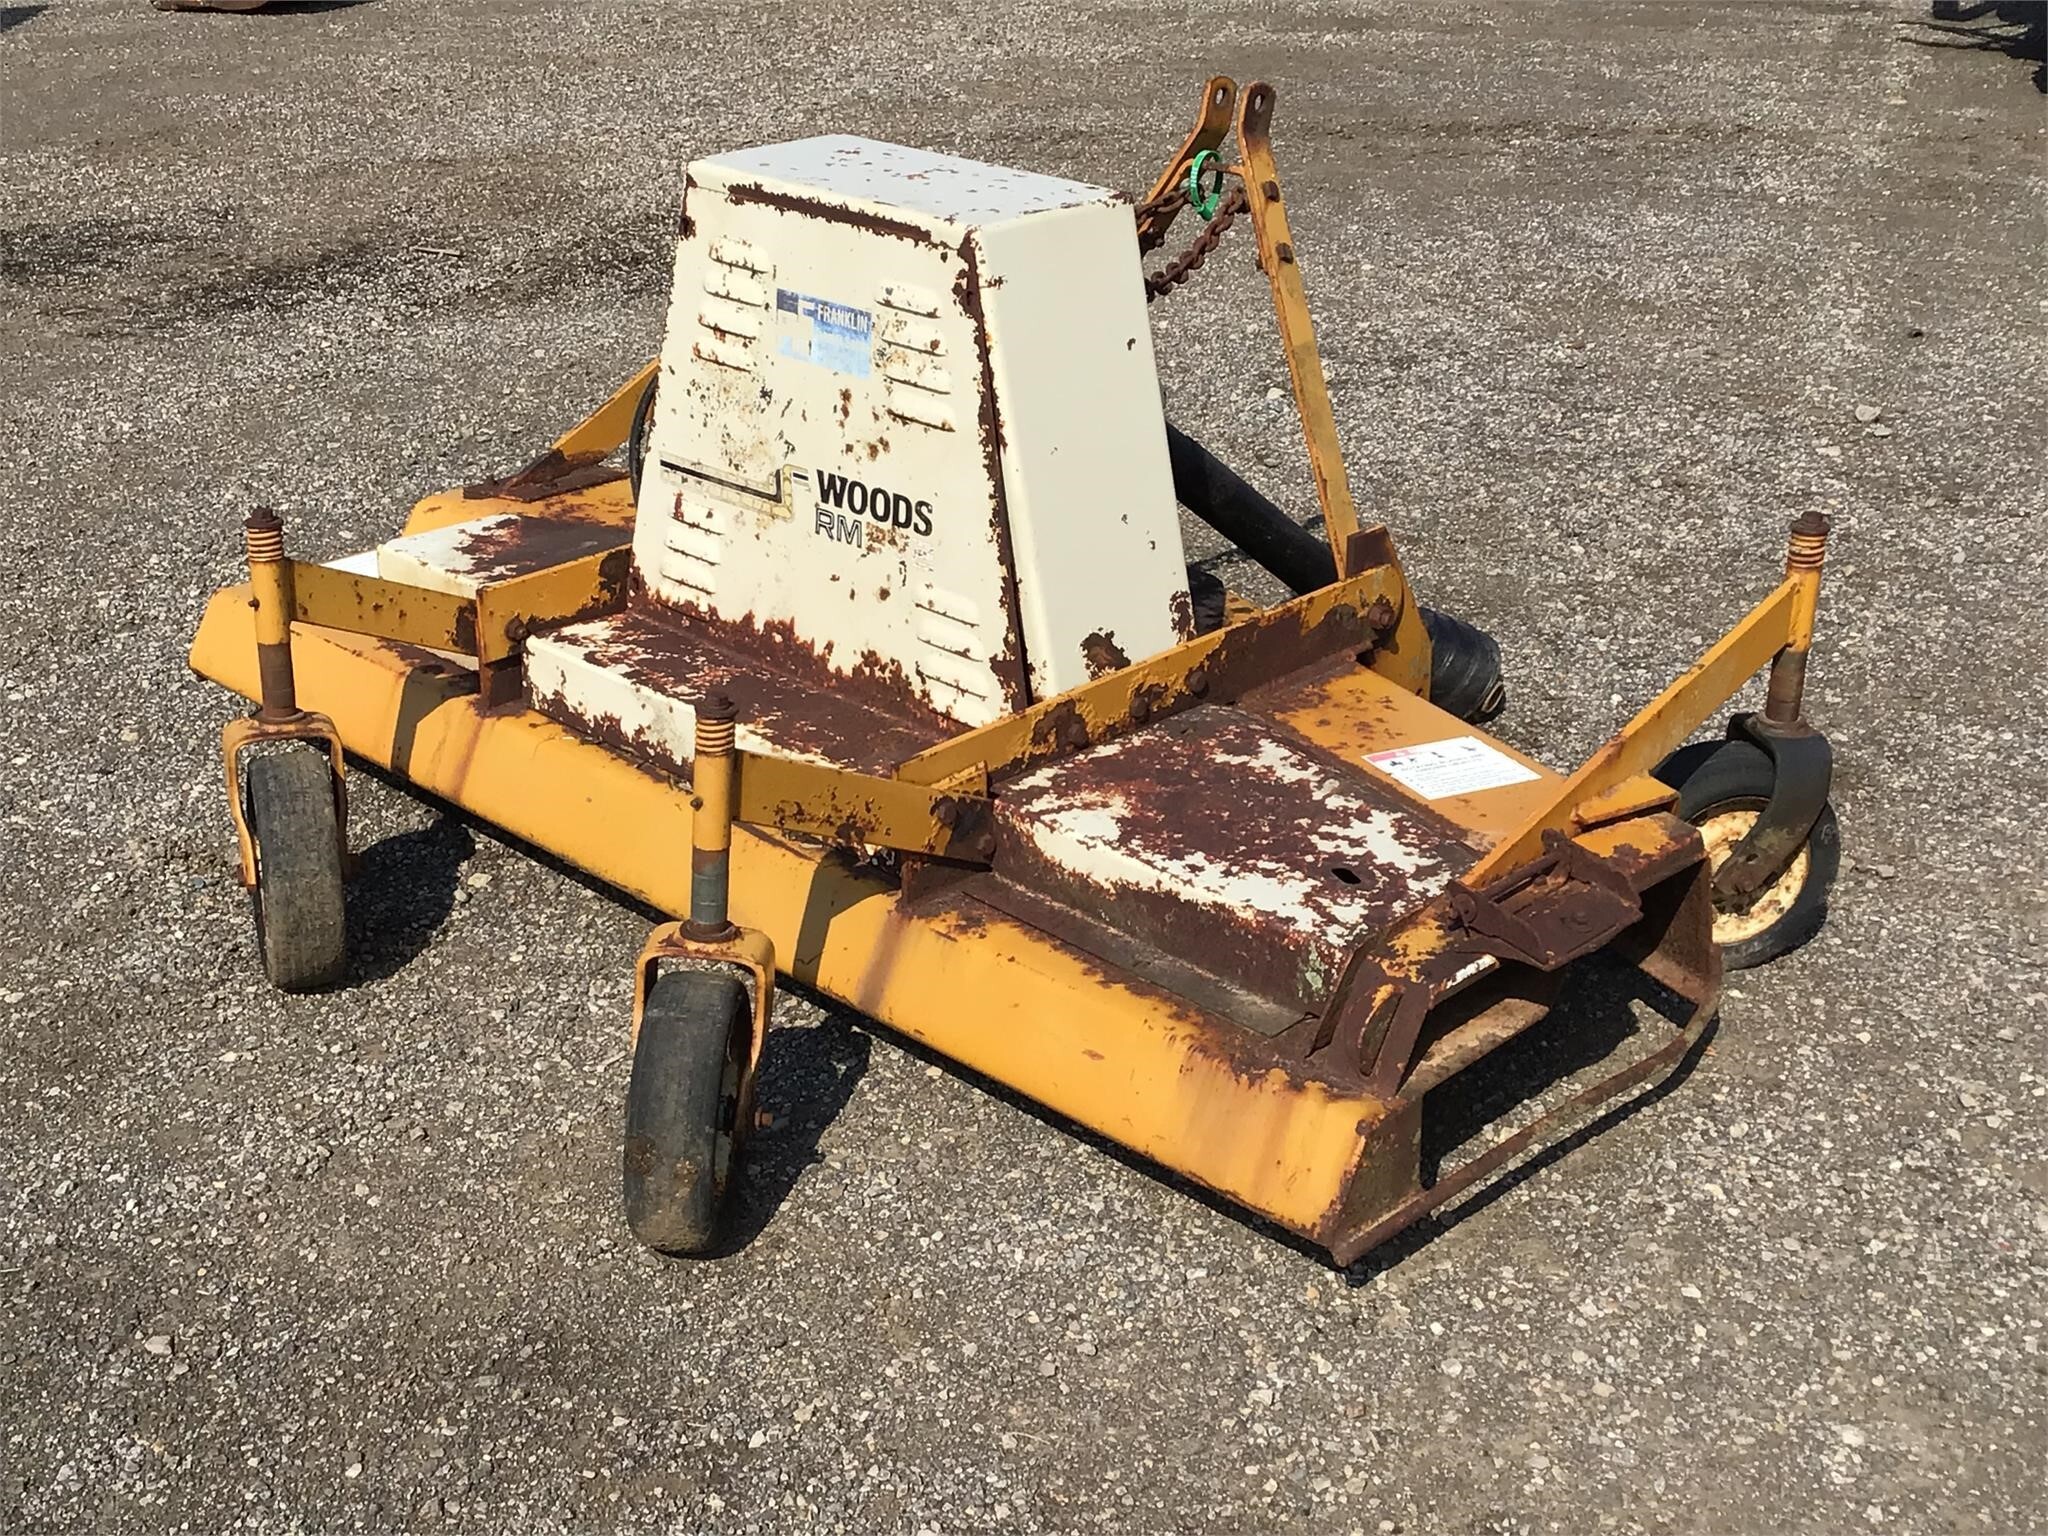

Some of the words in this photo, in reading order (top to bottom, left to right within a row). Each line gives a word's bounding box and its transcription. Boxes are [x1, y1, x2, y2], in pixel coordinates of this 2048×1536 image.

[817, 303, 868, 333] FRANKLIN
[816, 469, 933, 537] WOODS
[815, 507, 862, 549] RM
